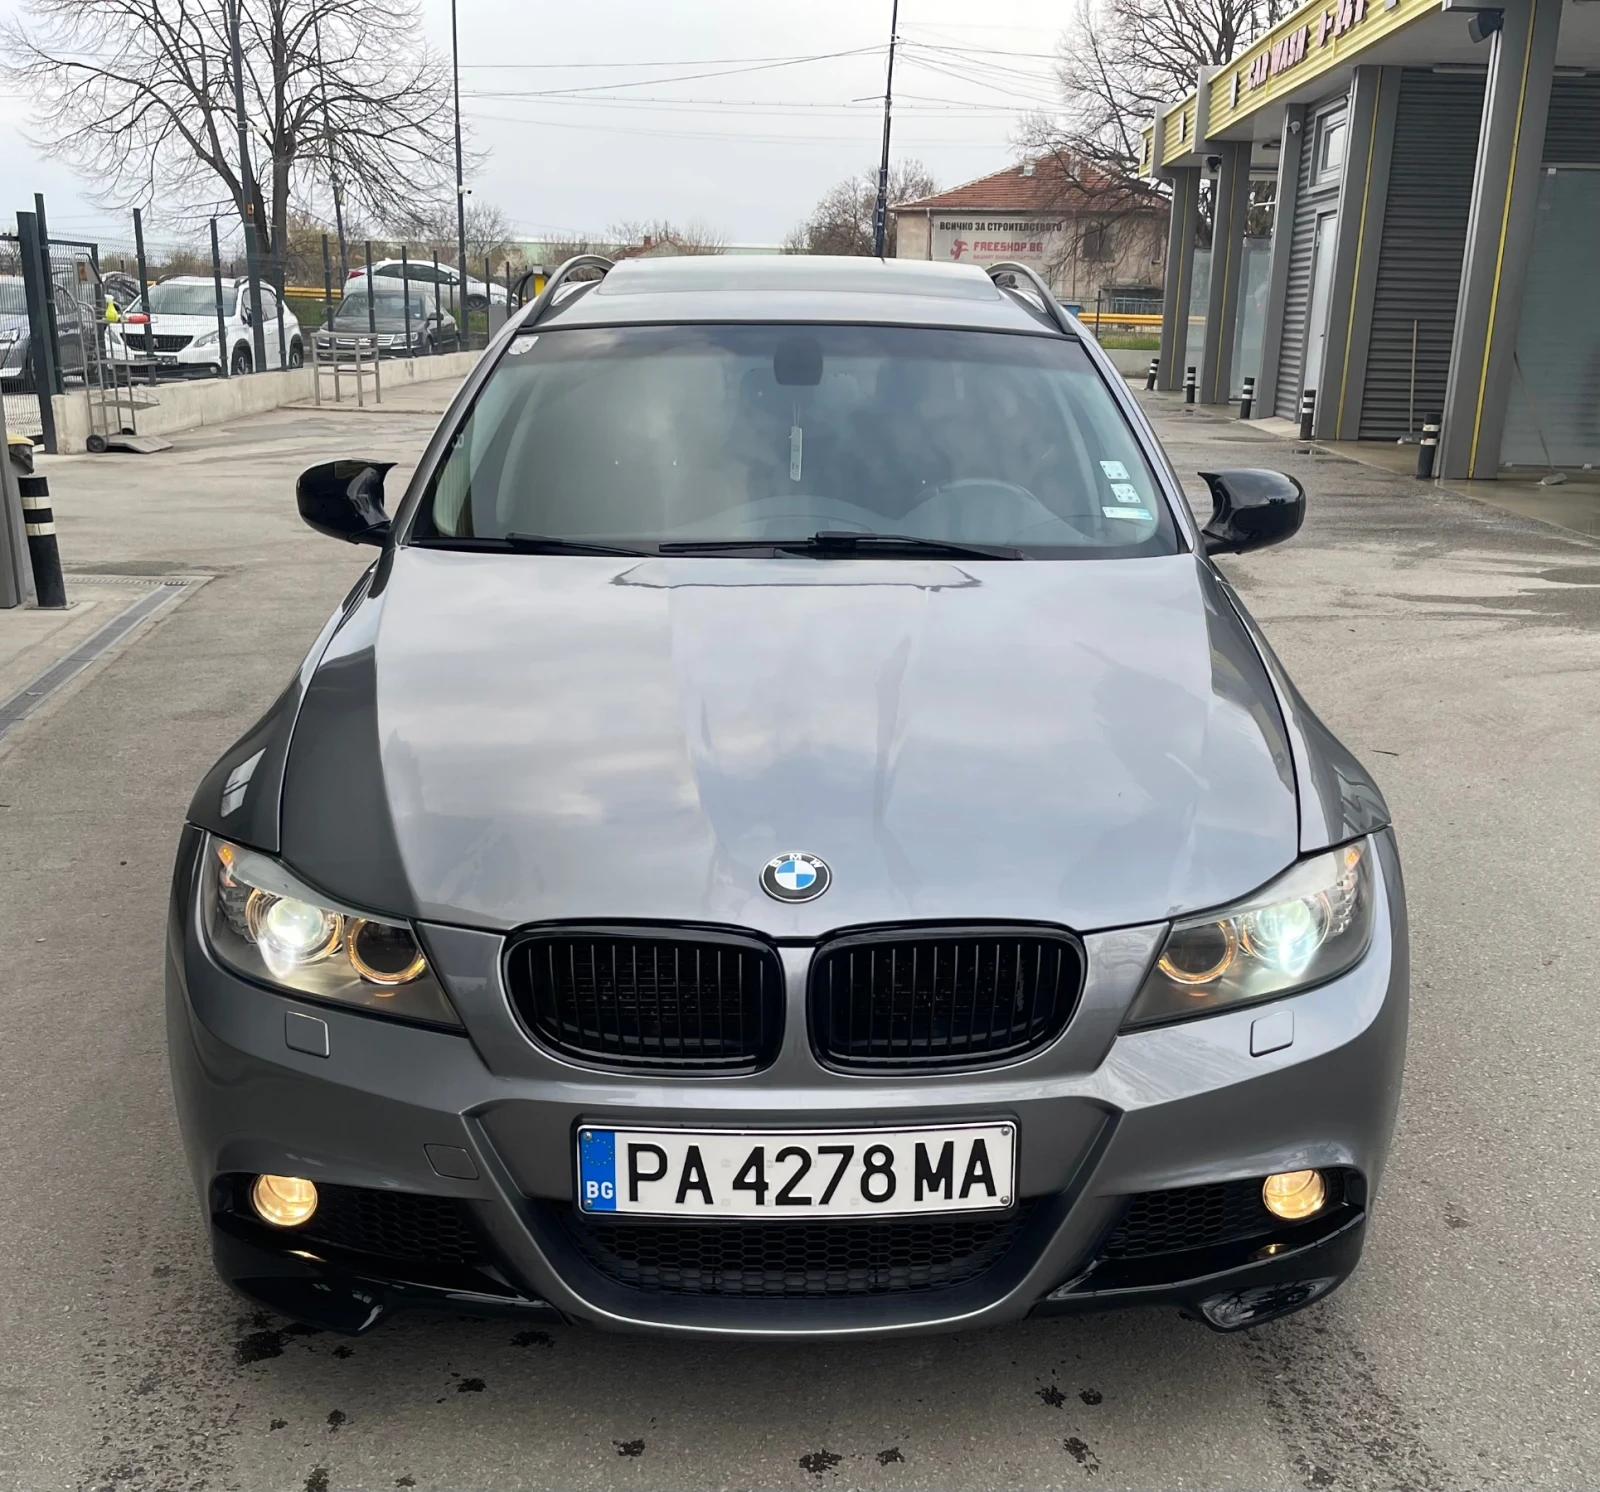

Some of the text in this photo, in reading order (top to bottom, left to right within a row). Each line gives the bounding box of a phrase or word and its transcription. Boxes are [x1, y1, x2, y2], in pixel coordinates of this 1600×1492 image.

[1247, 51, 1271, 91] CAR
[1271, 25, 1309, 76] WASH
[939, 221, 973, 232] ВСИЧКО
[975, 222, 986, 232] ЗА
[769, 853, 825, 868] BMW
[627, 1138, 998, 1206] PA 4278 MA
[586, 1180, 614, 1199] BG
